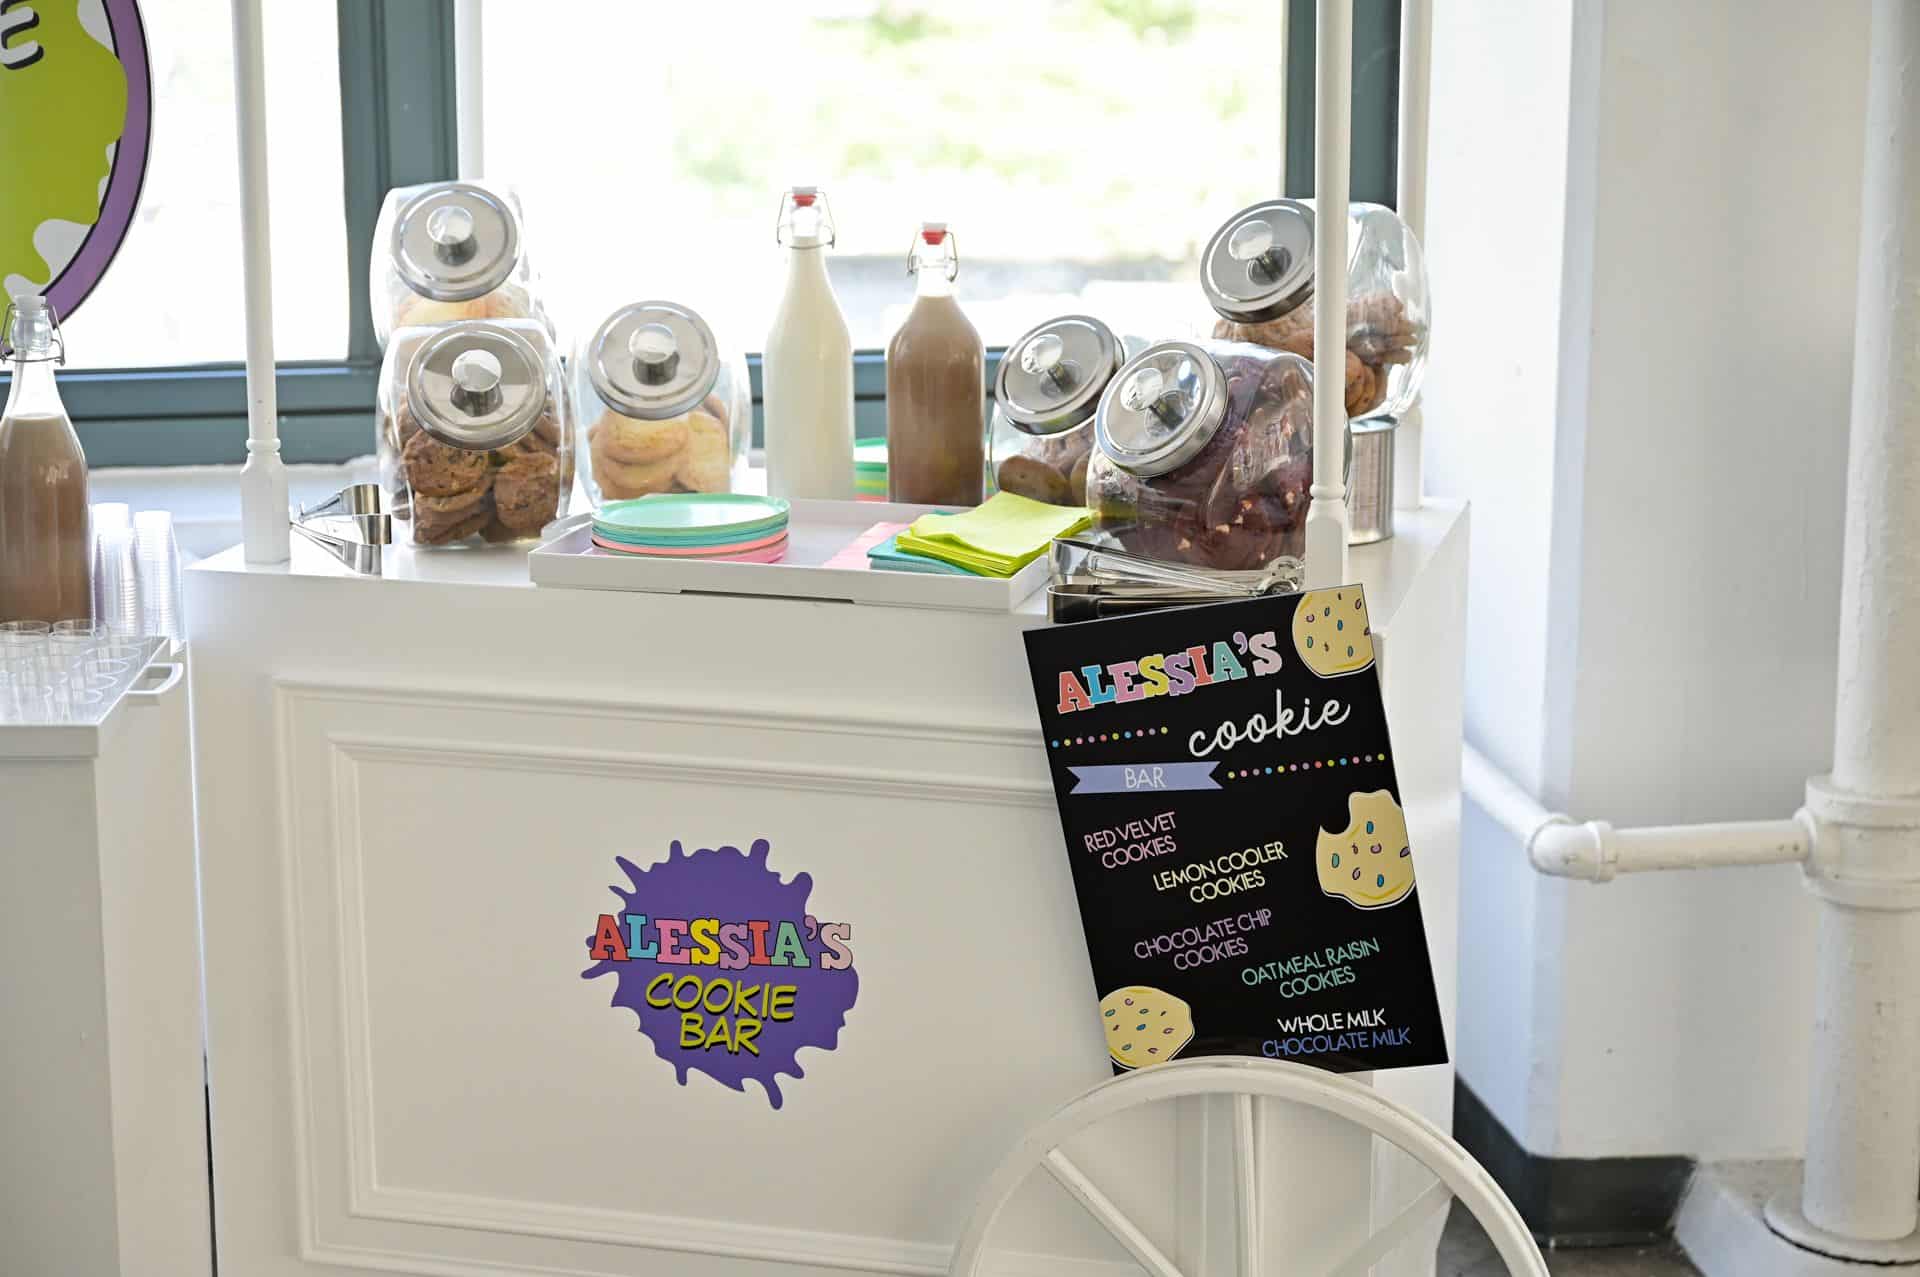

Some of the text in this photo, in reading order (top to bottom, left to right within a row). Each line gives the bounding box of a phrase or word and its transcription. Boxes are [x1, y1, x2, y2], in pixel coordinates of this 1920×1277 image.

[1056, 631, 1283, 714] ALESSIA'S
[1188, 689, 1350, 757] cookie
[1124, 767, 1167, 790] BAR
[1084, 811, 1176, 853] RED VELVET
[1102, 835, 1177, 869] COOKIES
[1153, 841, 1288, 891] LEMON COOLER
[1190, 869, 1265, 903] COOKIES
[589, 914, 853, 971] ALESSIA'S
[1134, 908, 1272, 959] CHOCOLATE CHIP
[1174, 937, 1249, 970] COOKIES
[1242, 937, 1380, 986] OATMEAL RAISIN
[1280, 966, 1356, 998] COOKIES
[646, 972, 797, 1021] COOKIE
[680, 1012, 762, 1056] BAR
[1262, 1027, 1412, 1057] CHOCOLATE MILK
[1277, 1008, 1387, 1034] WHOLE MILK
